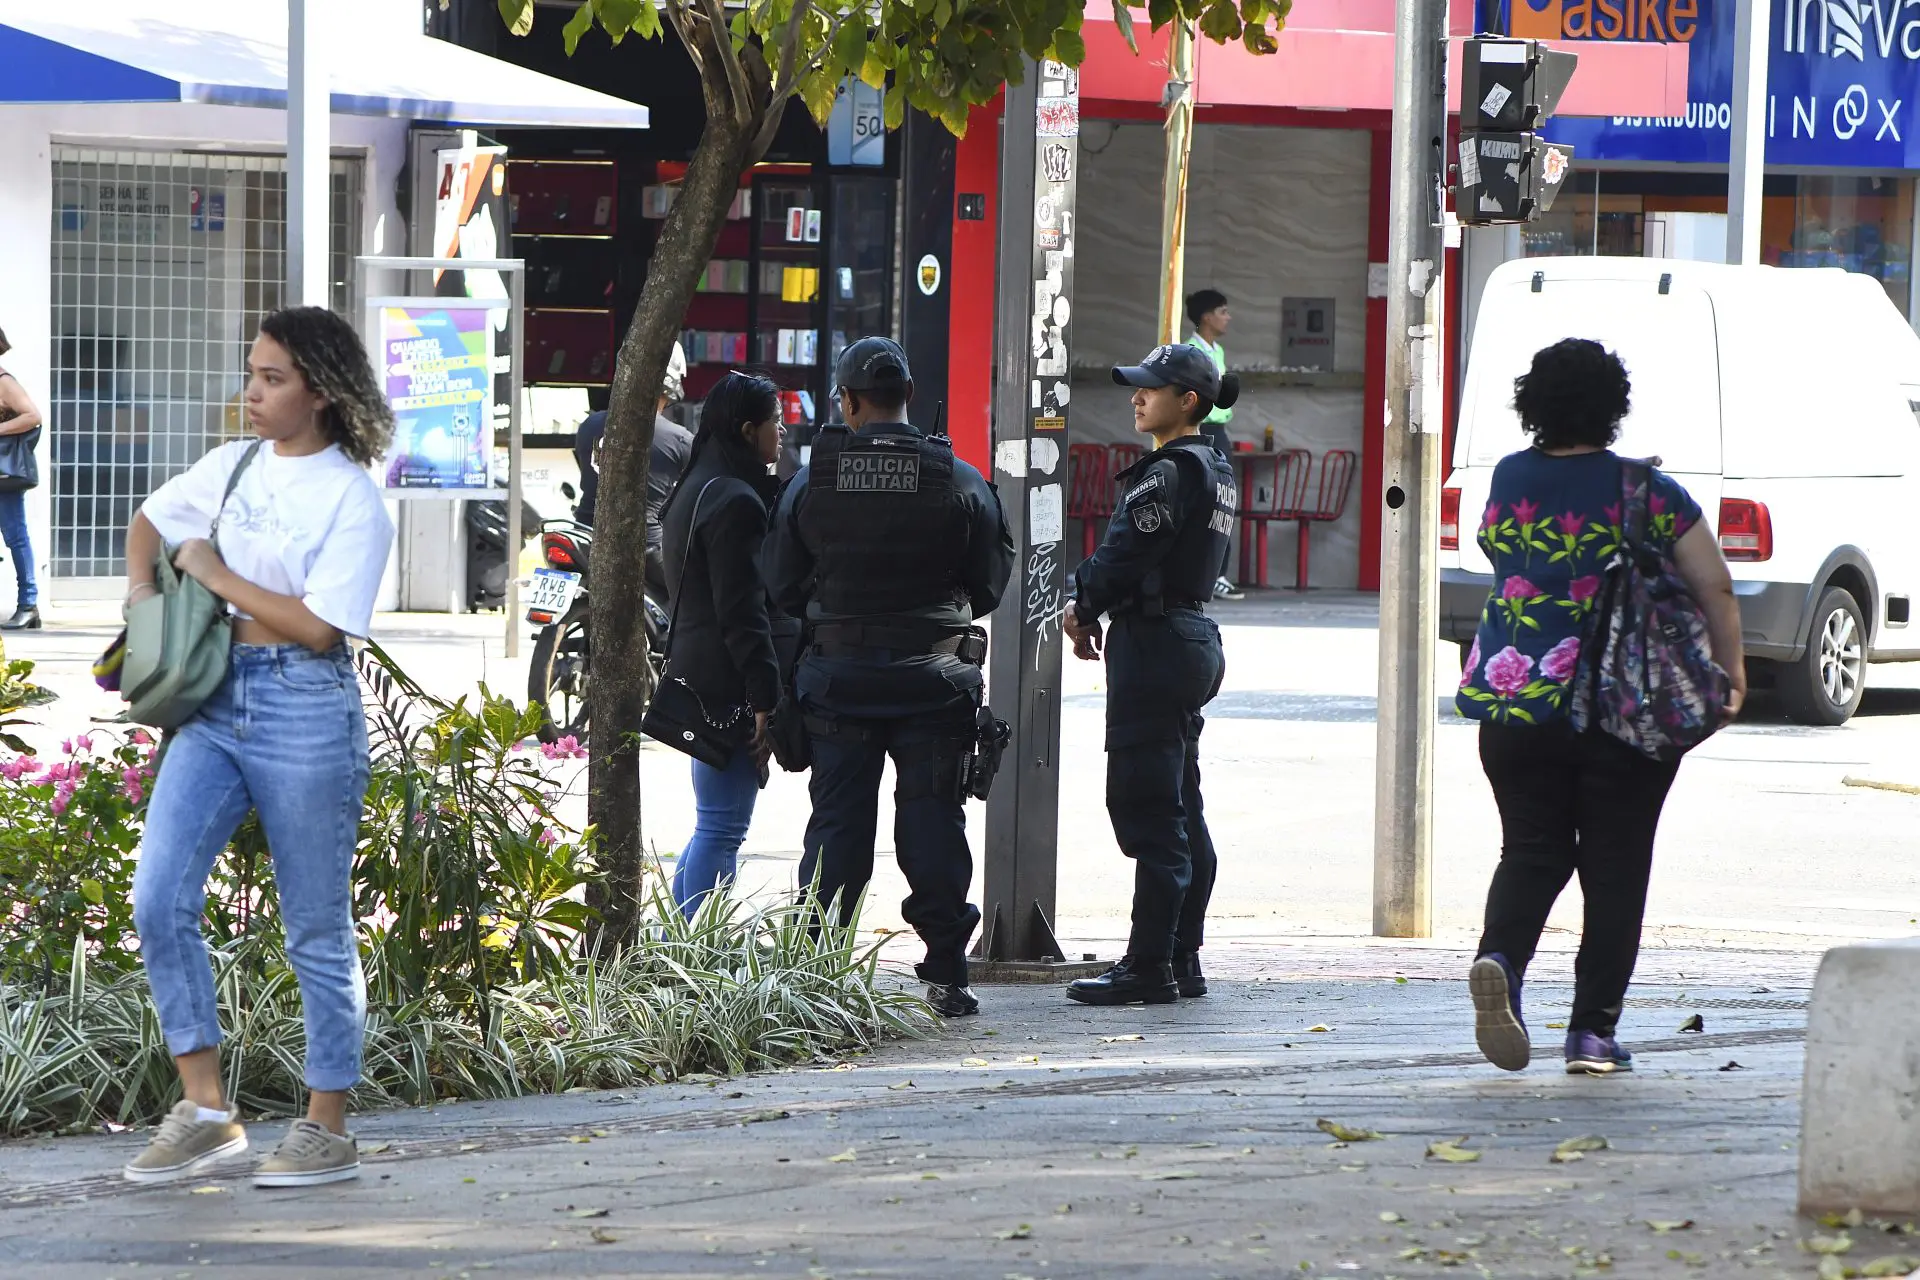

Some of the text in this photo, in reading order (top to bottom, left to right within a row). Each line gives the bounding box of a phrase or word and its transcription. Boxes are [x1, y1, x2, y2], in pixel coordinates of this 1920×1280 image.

[856, 115, 881, 137] 50
[840, 455, 916, 474] POLÍCIA
[838, 474, 916, 490] MILITAR
[1126, 478, 1156, 502] PMMS
[539, 576, 567, 594] RWB
[530, 590, 567, 608] 1A70
